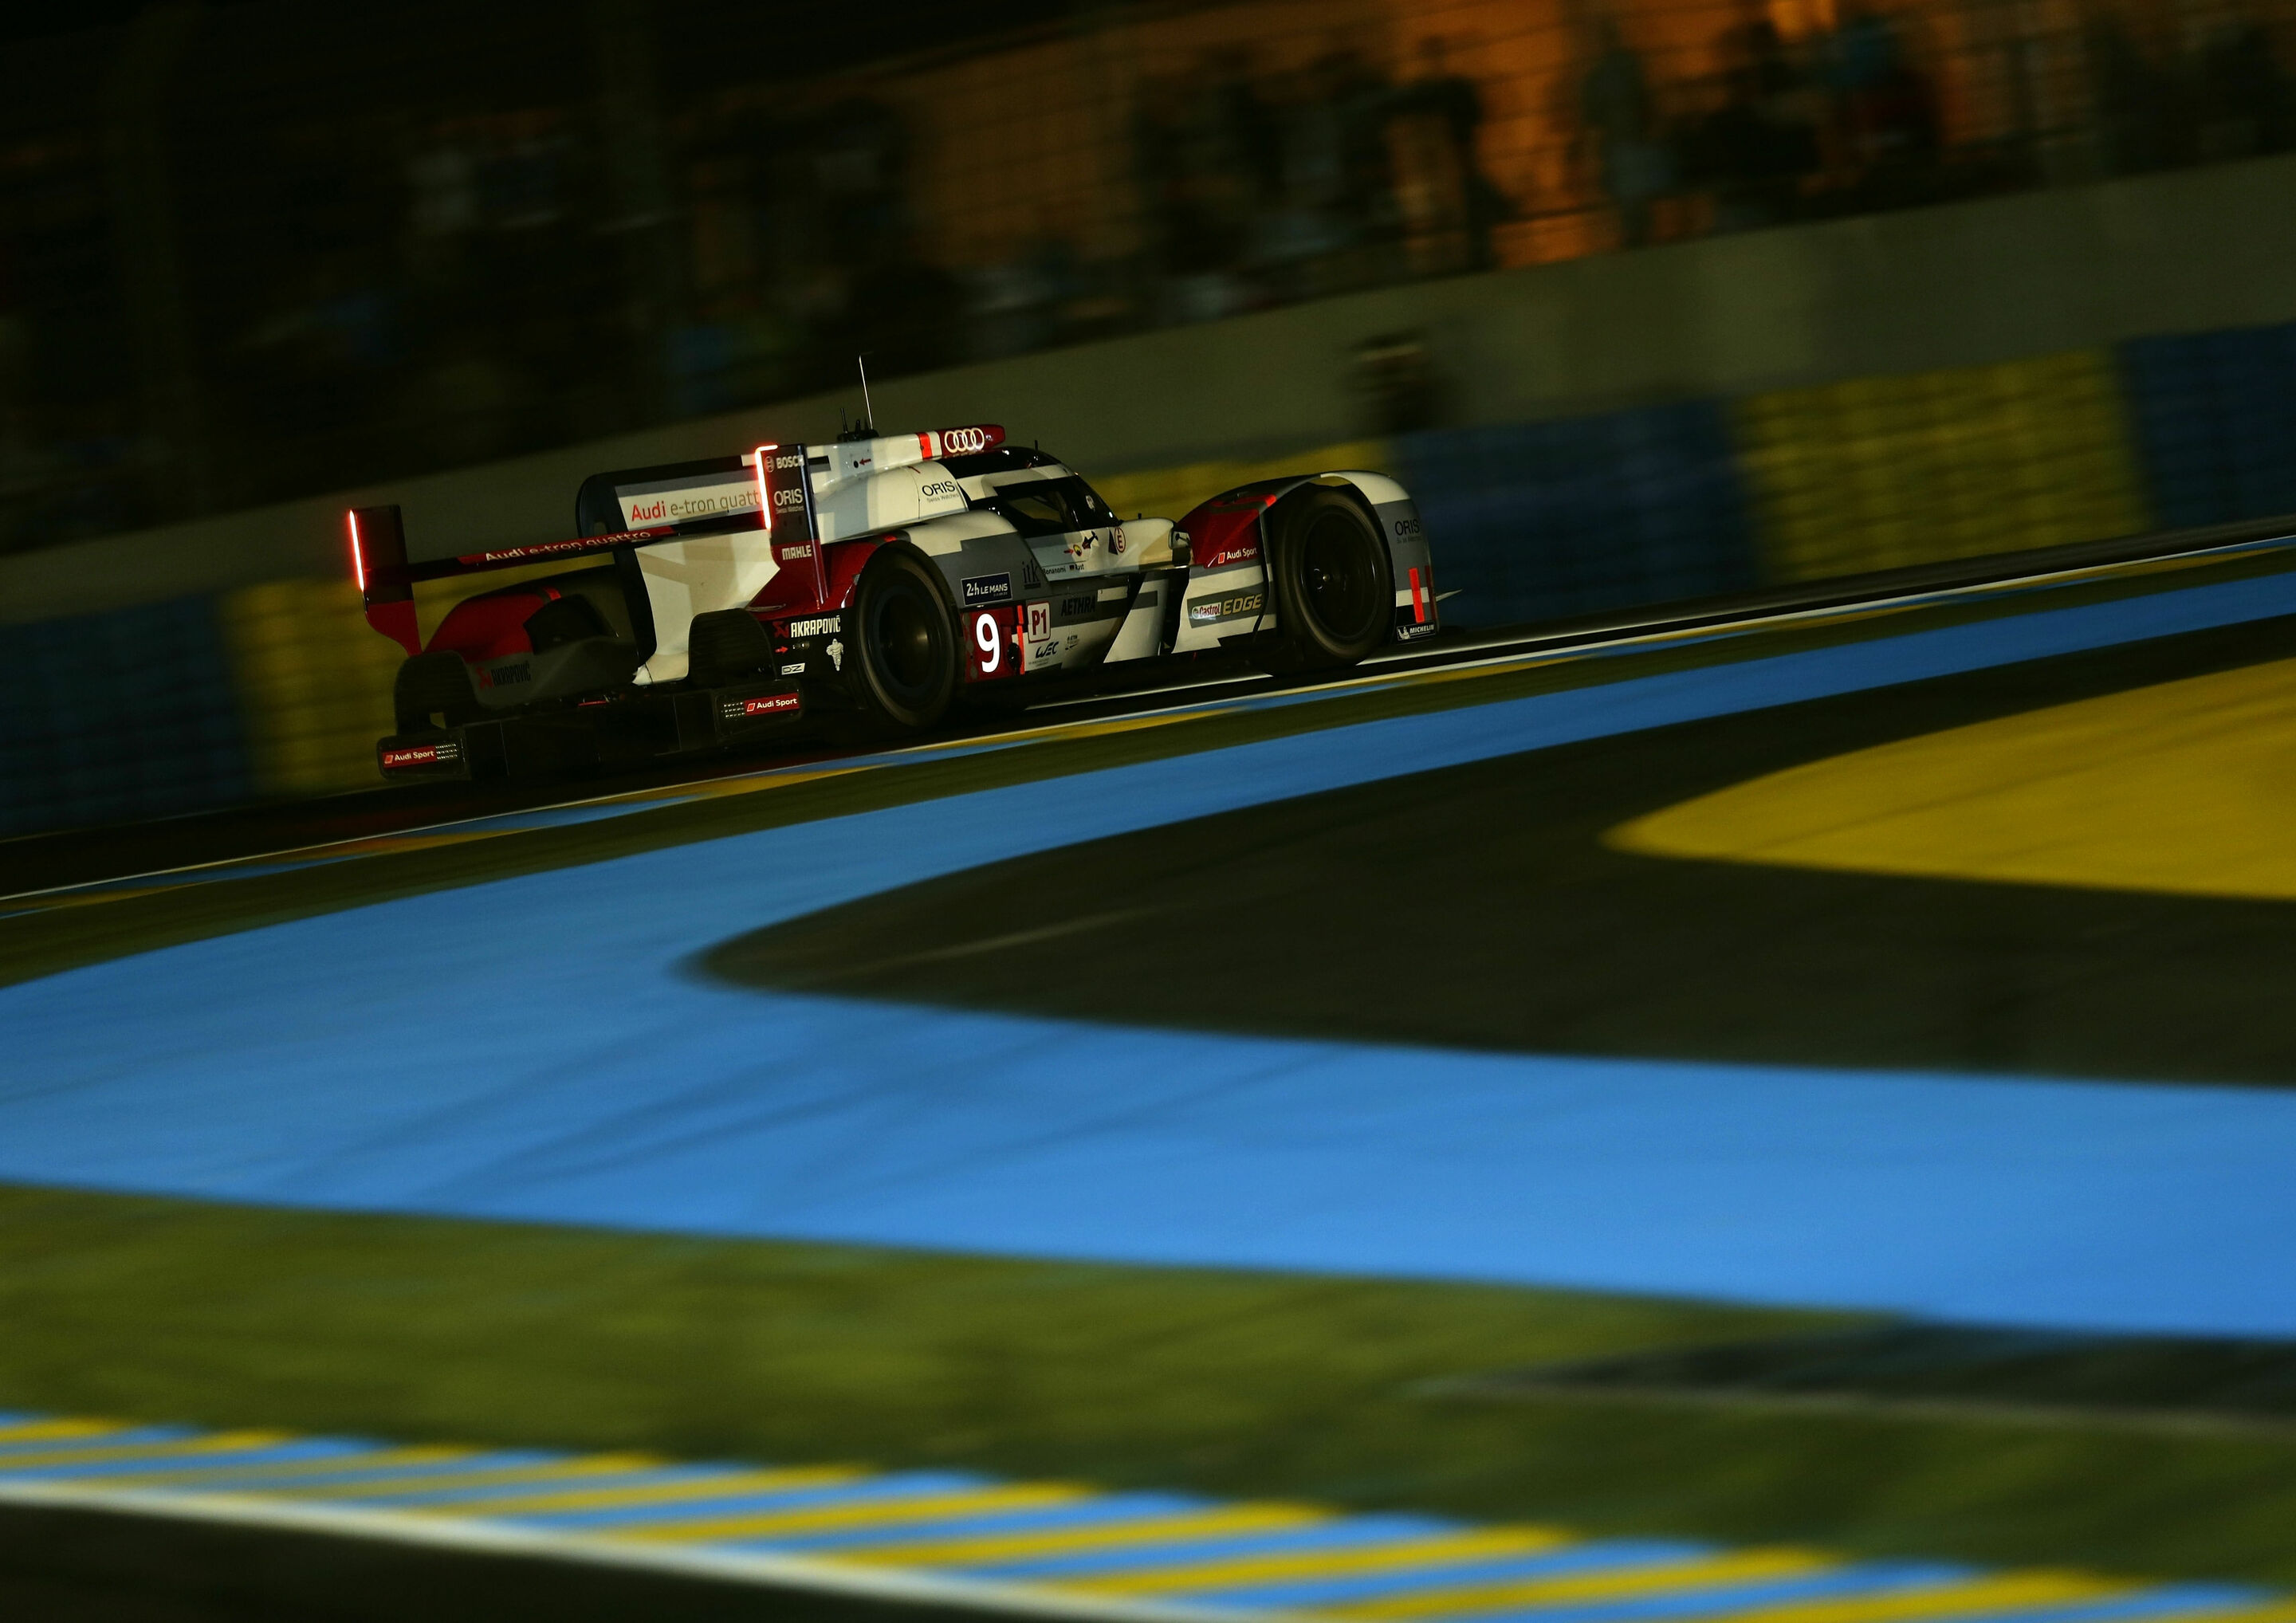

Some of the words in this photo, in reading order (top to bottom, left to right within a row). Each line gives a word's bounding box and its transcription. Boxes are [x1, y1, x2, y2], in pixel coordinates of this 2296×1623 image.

[773, 488, 804, 506] ORIS
[922, 481, 955, 497] ORIS
[631, 501, 666, 522] Audi
[670, 495, 715, 517] e-tron
[719, 489, 761, 511] quatt
[1395, 519, 1420, 536] ORIS
[486, 548, 525, 561] Audi
[529, 540, 583, 555] e-tron
[586, 531, 651, 546] quattro
[781, 545, 813, 560] MAHLE
[1227, 549, 1242, 560] Audi
[1243, 548, 1258, 559] Sport
[981, 586, 989, 595] LE
[989, 583, 1008, 594] MANS
[1061, 596, 1097, 617] AETHRA
[1198, 603, 1221, 618] Castrol
[1222, 593, 1263, 616] EDGE
[1032, 609, 1048, 635] P1
[1409, 623, 1435, 634] MICHELIN
[976, 613, 1001, 674] 9
[1036, 641, 1060, 659] WEC
[757, 701, 774, 710] Audi
[776, 698, 798, 709] Sport
[394, 752, 412, 762] Audi
[413, 750, 434, 760] Sport
